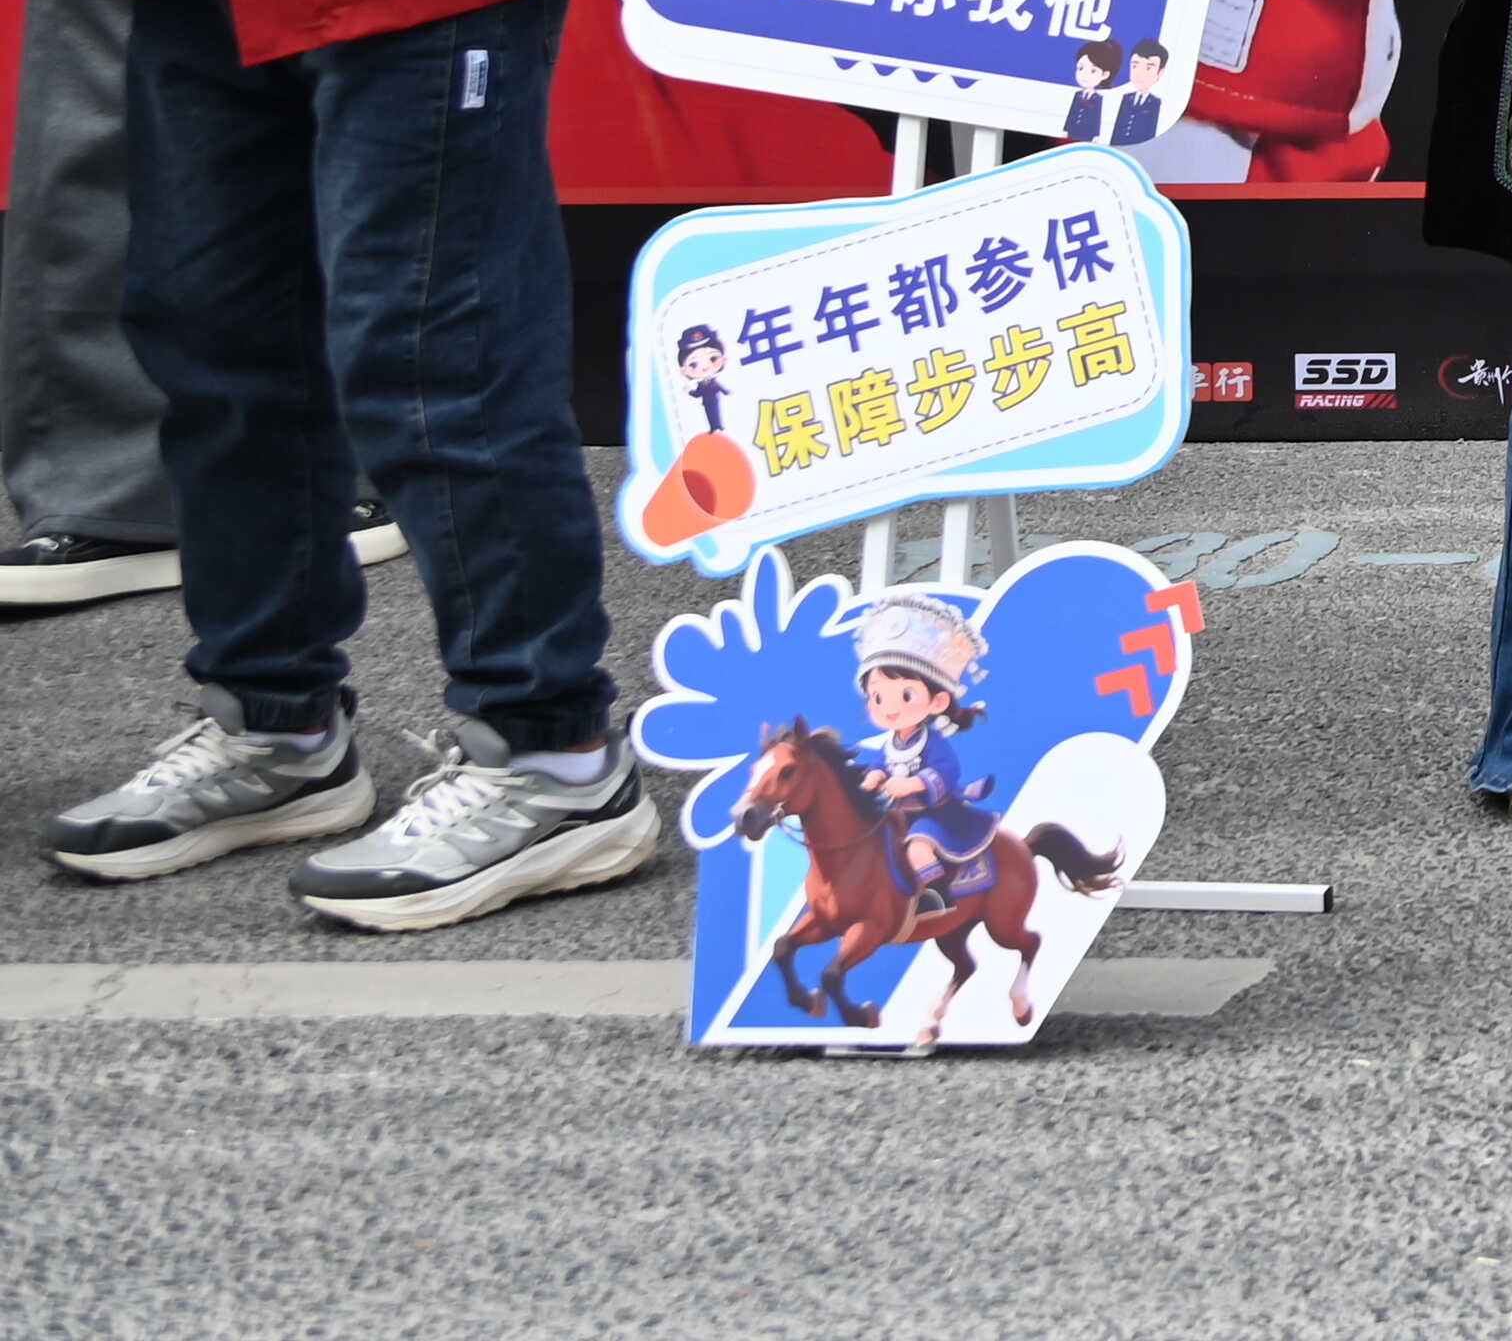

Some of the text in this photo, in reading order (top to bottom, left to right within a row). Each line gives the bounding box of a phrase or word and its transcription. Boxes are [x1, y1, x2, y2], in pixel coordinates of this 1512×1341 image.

[737, 209, 1116, 376] 年年都参保
[753, 298, 1137, 478] 保障步步高
[1299, 393, 1365, 408] RACING
[1302, 359, 1390, 385] SSD
